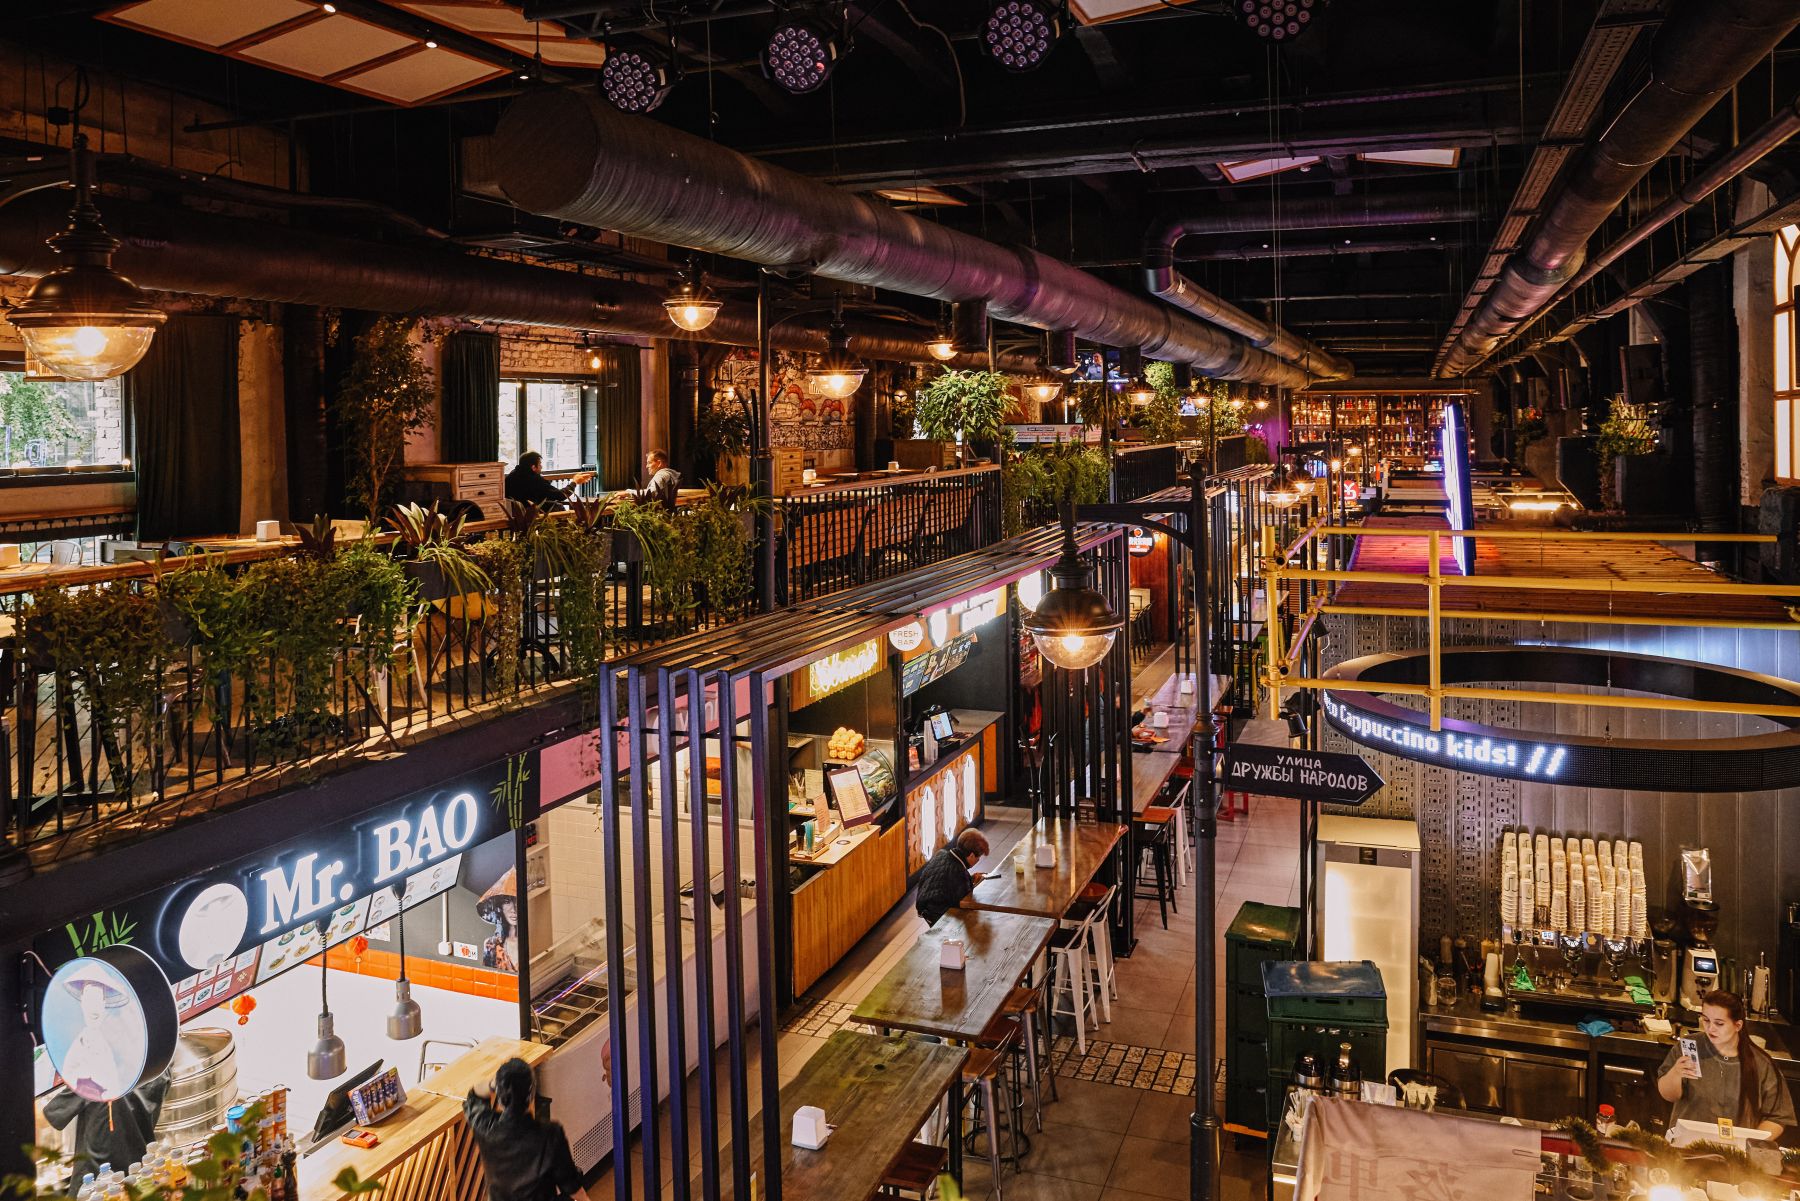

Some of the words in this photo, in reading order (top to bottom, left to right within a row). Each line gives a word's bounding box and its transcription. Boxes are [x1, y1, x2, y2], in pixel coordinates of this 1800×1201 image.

[893, 630, 919, 639] FRESH
[1340, 705, 1440, 752] Cappuccino
[1446, 733, 1516, 768] kids!
[1231, 761, 1294, 783] ДРУЖБЫ
[1299, 768, 1368, 791] НАРОДОВ
[1277, 754, 1322, 770] УЛИЦА
[260, 852, 354, 934] Mr.
[374, 793, 478, 883] BAO
